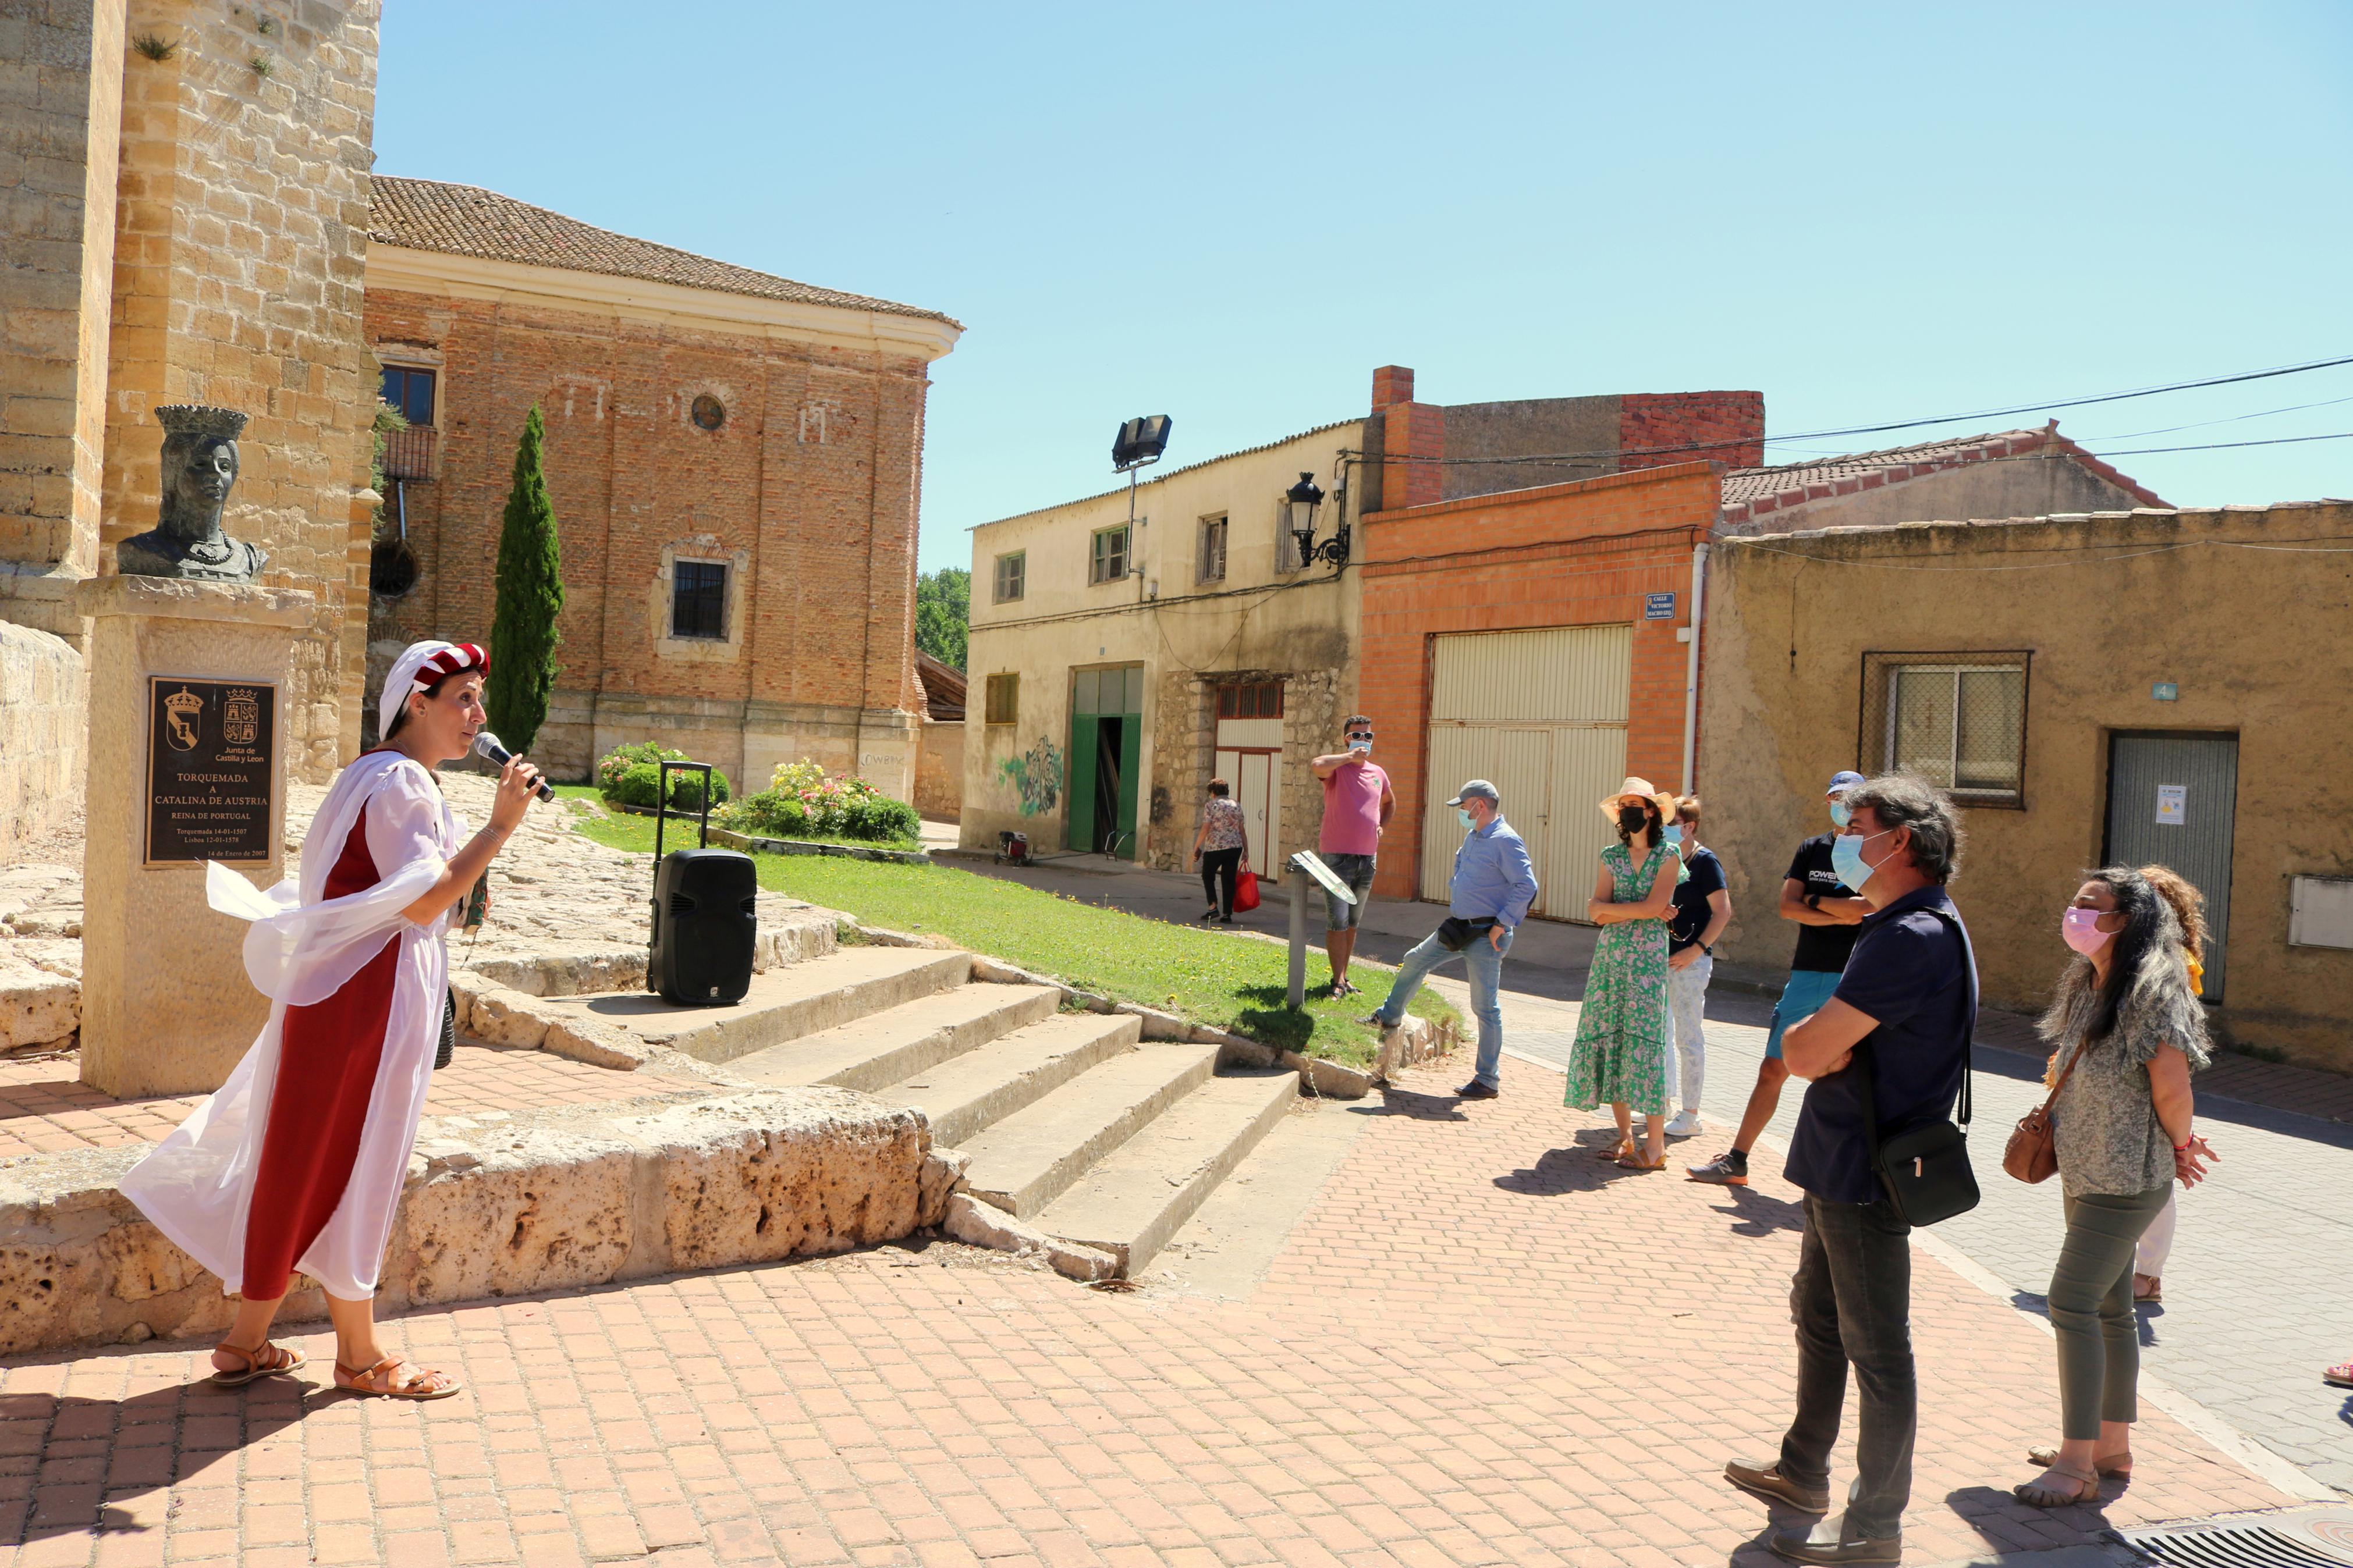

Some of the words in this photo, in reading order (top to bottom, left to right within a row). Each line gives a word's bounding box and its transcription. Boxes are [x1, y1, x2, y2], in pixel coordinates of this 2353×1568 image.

[2160, 685, 2167, 696] 4
[177, 773, 249, 783] TORQUEMADA
[155, 795, 206, 804] CATALINA
[209, 797, 222, 805] DE
[225, 797, 268, 805] AUSTRIA
